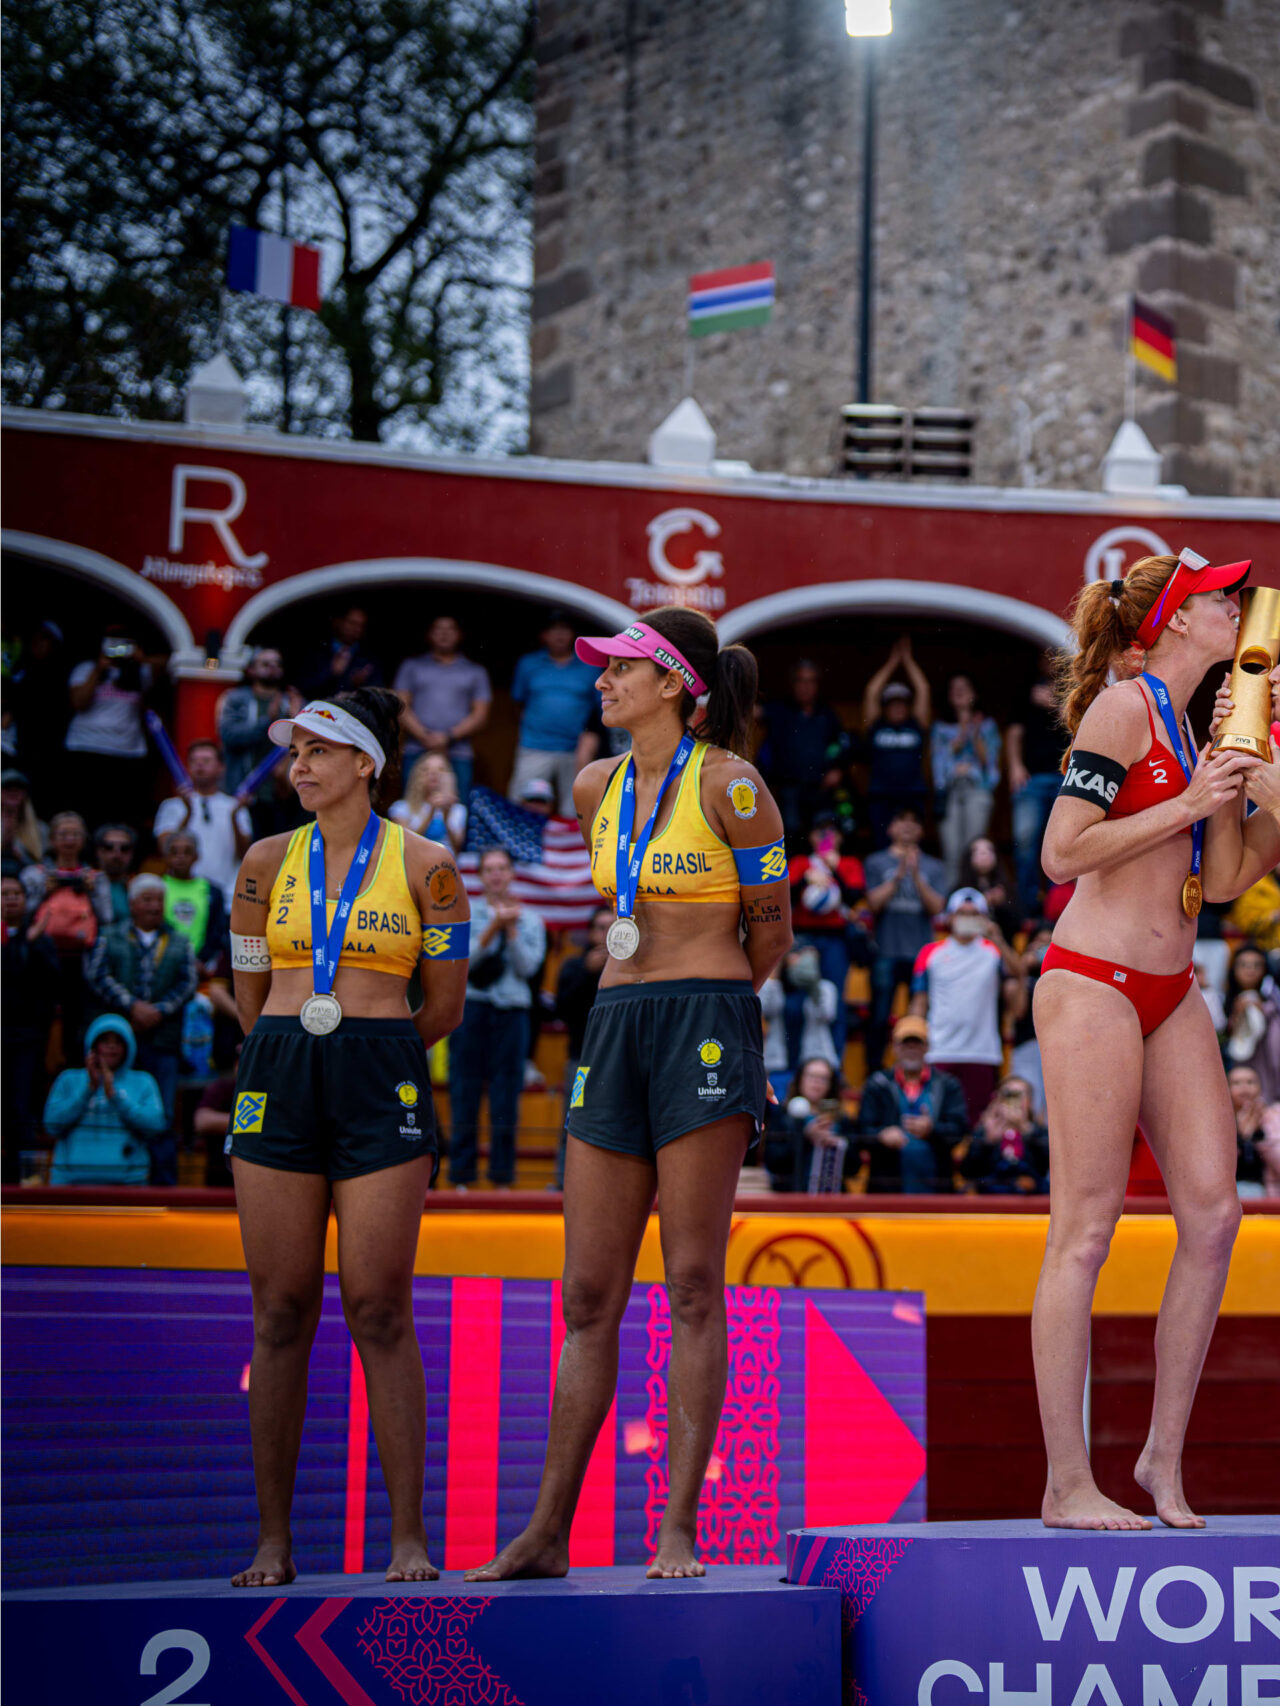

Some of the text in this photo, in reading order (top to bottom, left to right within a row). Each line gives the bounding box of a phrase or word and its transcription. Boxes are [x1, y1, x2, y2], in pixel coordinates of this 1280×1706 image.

[655, 648, 695, 688] ZINZANE
[1157, 687, 1168, 705] FIVB
[1152, 769, 1168, 784] 2
[1062, 768, 1119, 804] IKAS
[631, 860, 640, 877] FIVB
[652, 852, 712, 875] BRASIL
[602, 886, 677, 896] TLCALA
[276, 906, 289, 925] 2
[341, 902, 350, 918] FIVB
[357, 910, 411, 935] BRASIL
[291, 940, 376, 954] TLALA
[233, 954, 272, 966] ADCO
[698, 1086, 727, 1096] Uniube
[140, 1629, 211, 1706] 2
